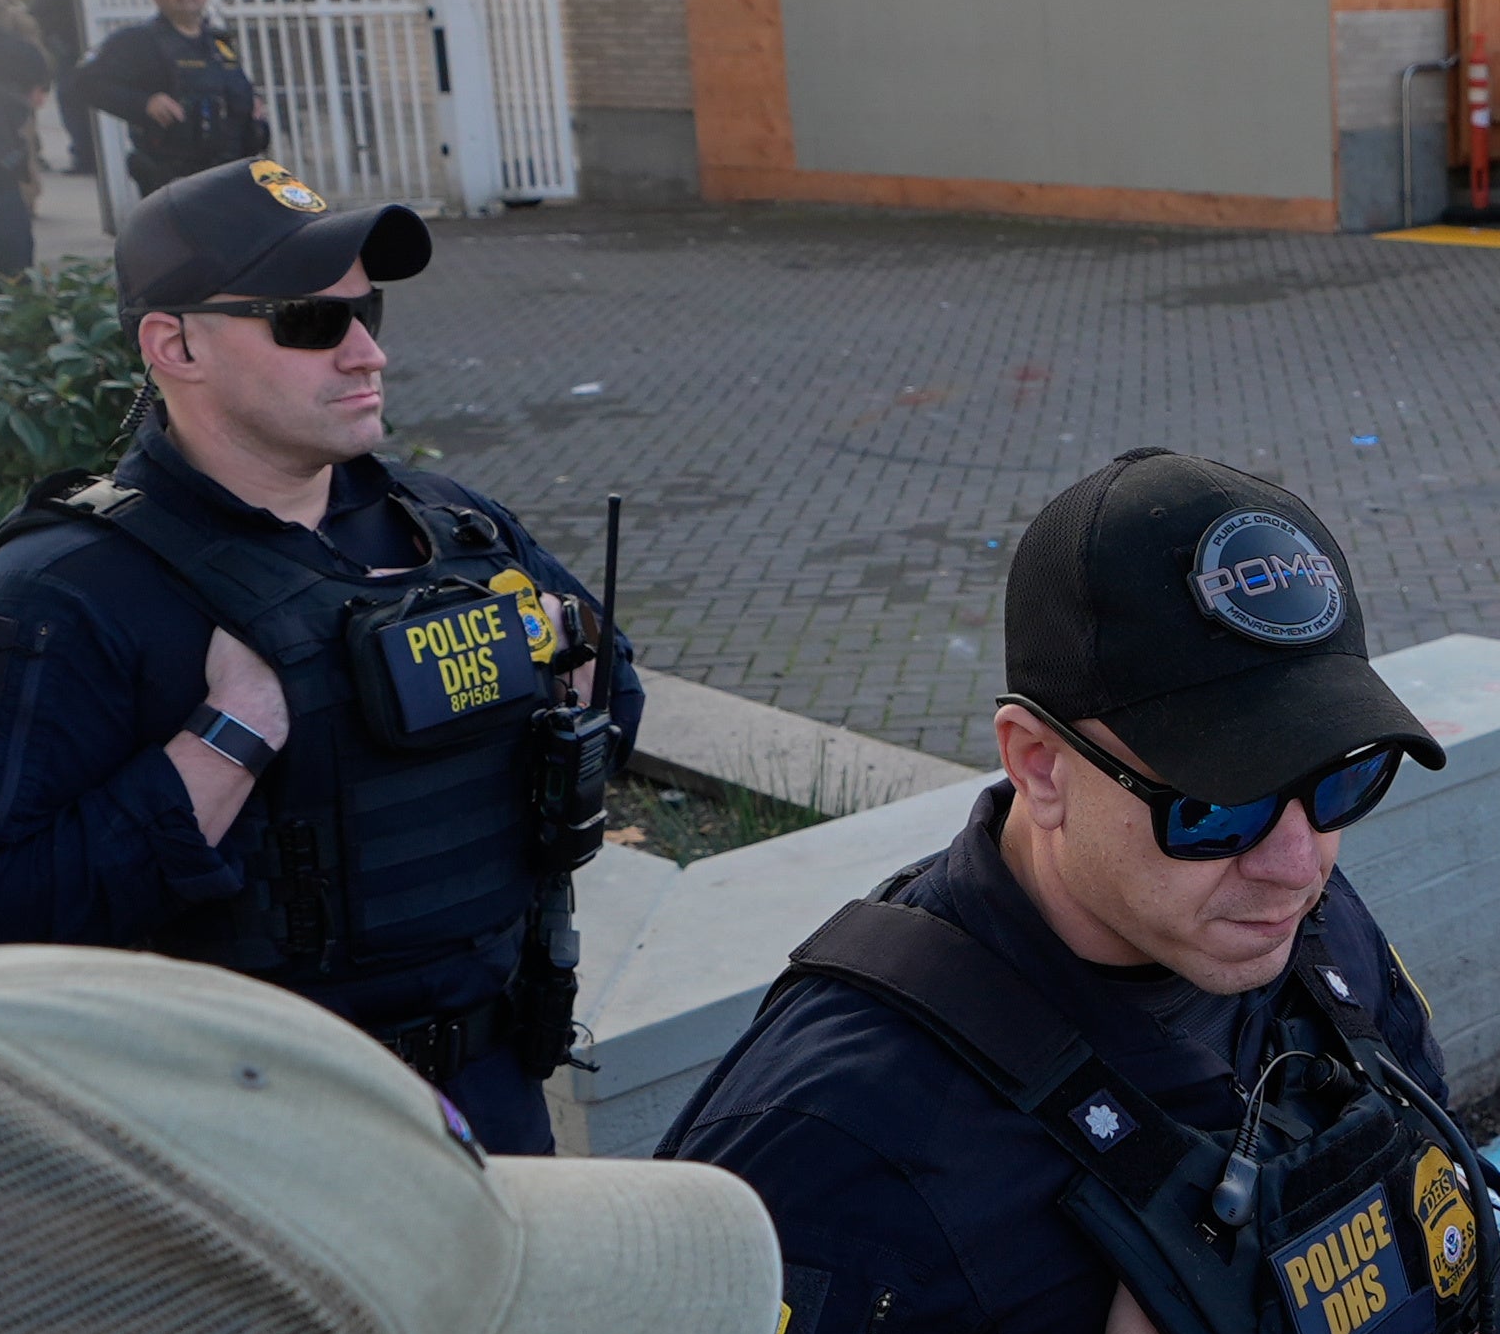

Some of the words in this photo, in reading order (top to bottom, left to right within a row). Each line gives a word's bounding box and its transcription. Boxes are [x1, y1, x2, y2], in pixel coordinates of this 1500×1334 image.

[1212, 516, 1253, 547] PUBLIC
[1253, 515, 1297, 537] ORDER
[1196, 553, 1344, 611] POMA
[405, 603, 507, 665] POLICE
[1225, 605, 1314, 636] MANAGEMENT
[438, 646, 499, 696] DHS
[450, 681, 500, 713] 8P1582
[1422, 1173, 1452, 1214] DHS
[1284, 1198, 1392, 1310] POLICE
